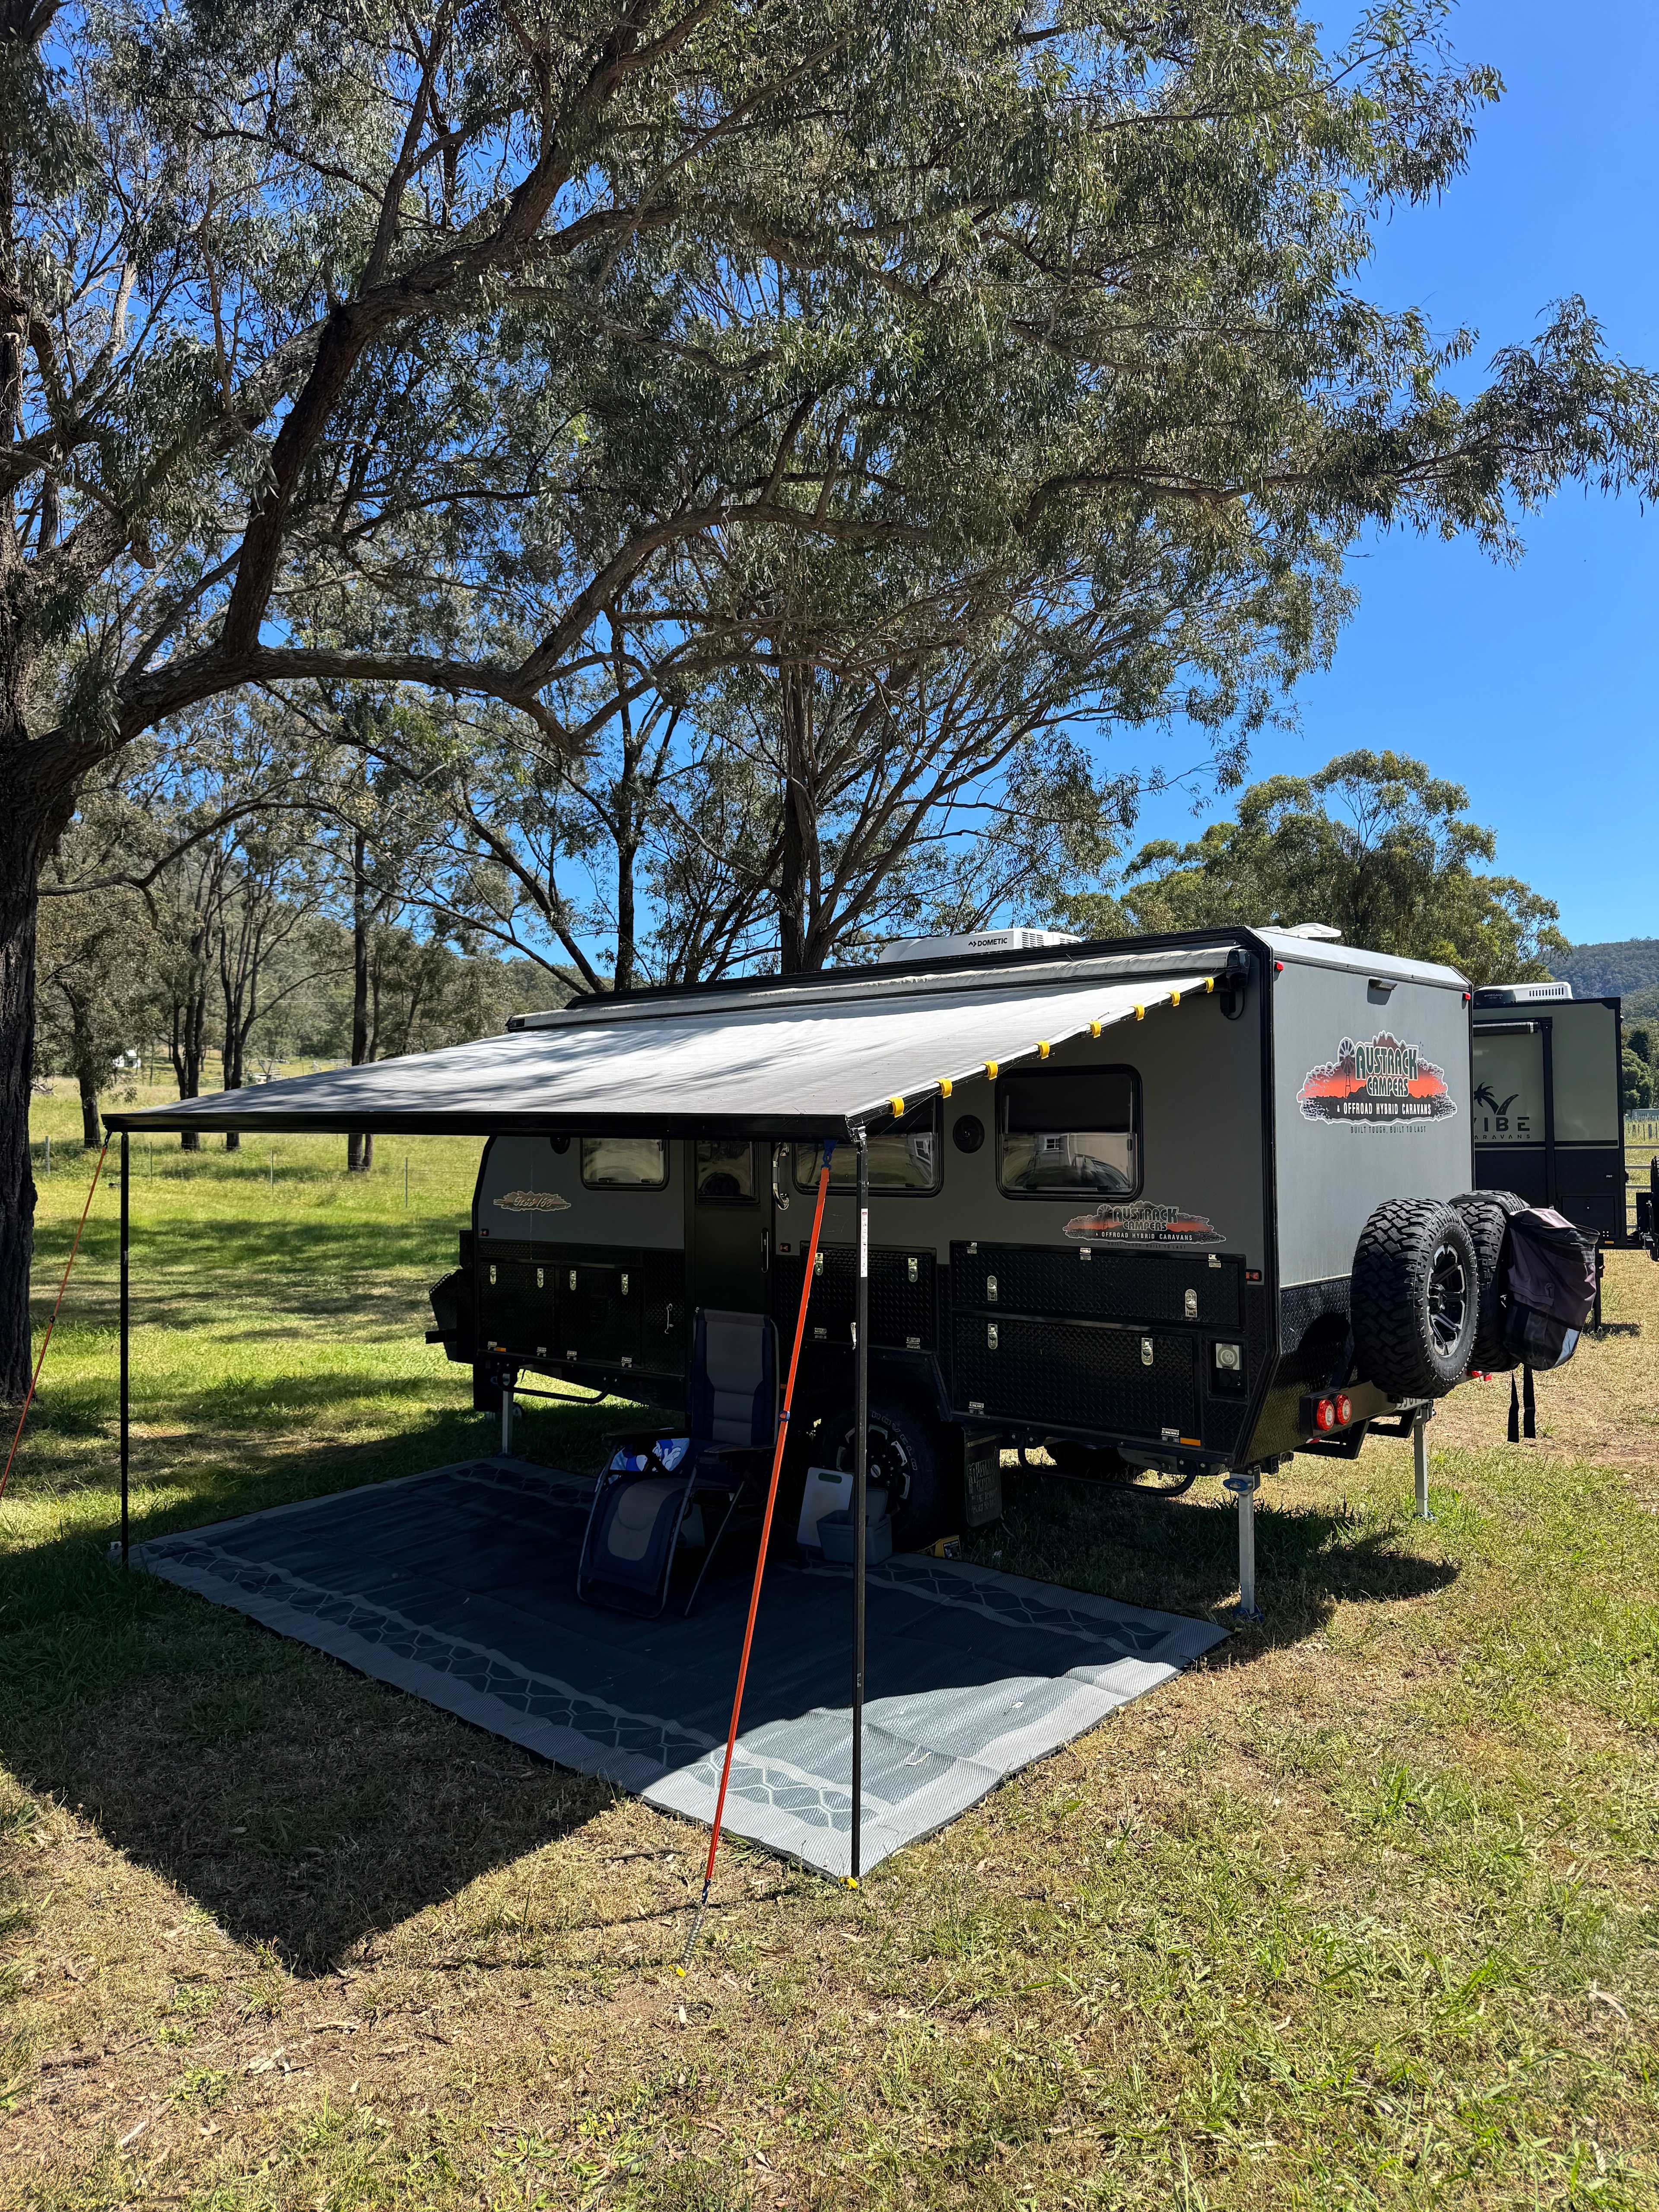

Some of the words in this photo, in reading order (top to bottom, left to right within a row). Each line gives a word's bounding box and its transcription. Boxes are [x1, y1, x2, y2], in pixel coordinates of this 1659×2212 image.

[977, 938, 1007, 947] DOMETIC
[1356, 1045, 1418, 1080] AUSTRACK
[1367, 1076, 1409, 1096] CAMPERS
[1344, 1103, 1373, 1115] OFFROAD
[1376, 1103, 1398, 1115] HYBRID
[1402, 1103, 1431, 1115] CARAVANS
[1474, 1116, 1530, 1131] IBE
[1112, 1207, 1179, 1224] AUSTRACK
[1123, 1221, 1167, 1231] CAMPERS
